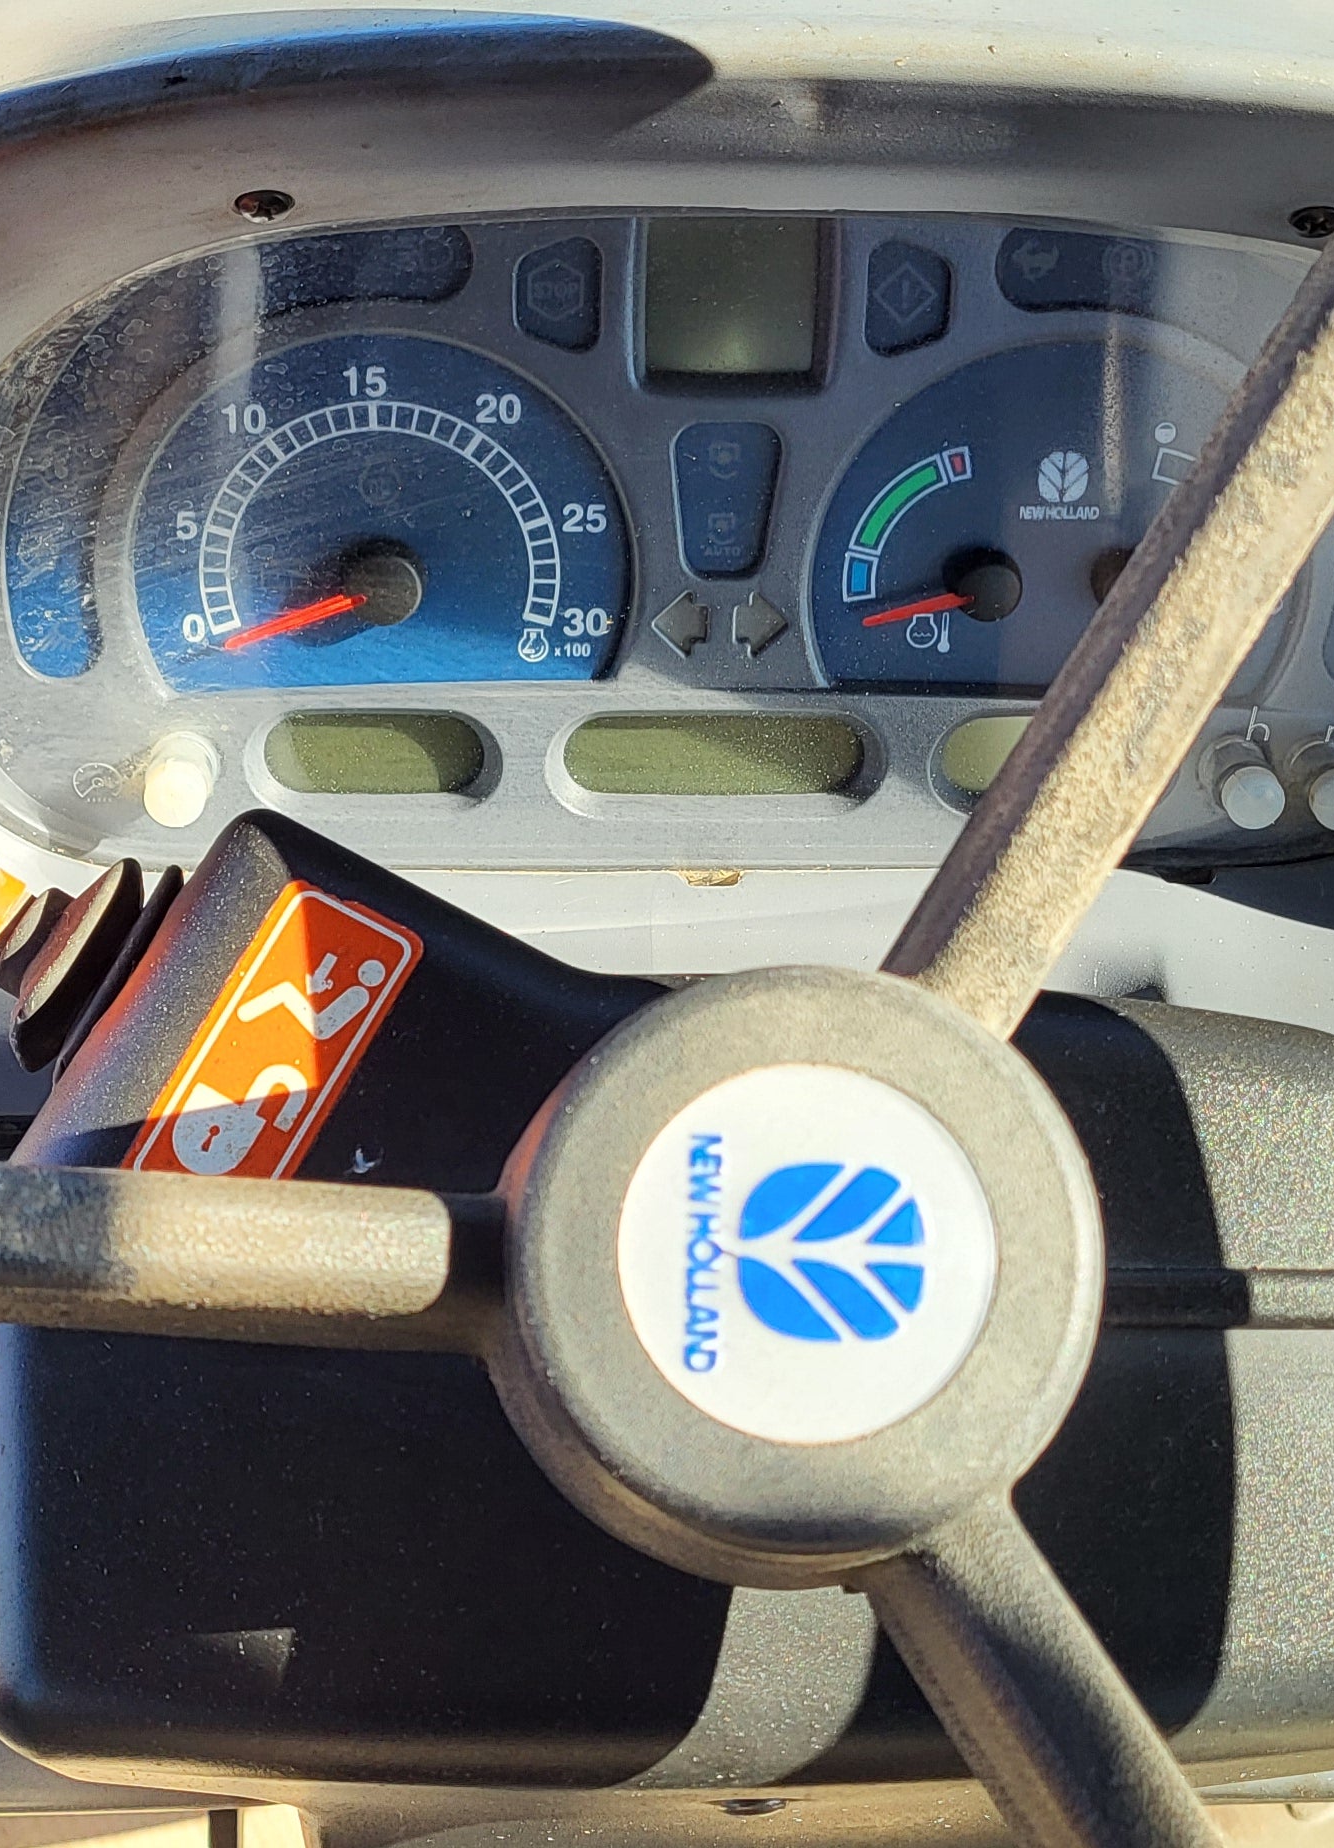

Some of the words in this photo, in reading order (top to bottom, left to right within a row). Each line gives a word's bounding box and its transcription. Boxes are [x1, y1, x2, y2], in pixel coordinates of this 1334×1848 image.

[343, 366, 387, 398] 15
[221, 403, 267, 434] 10
[475, 393, 522, 425] 20
[176, 511, 198, 541] 5
[562, 503, 607, 533] 25
[1019, 505, 1045, 520] NEW
[1046, 505, 1100, 521] HOLLAND
[704, 546, 741, 557] AUTO
[182, 613, 205, 643] 0
[562, 607, 608, 637] 30
[1245, 705, 1271, 741] h
[688, 1133, 723, 1205] NEW
[682, 1212, 722, 1373] HOLLAND
